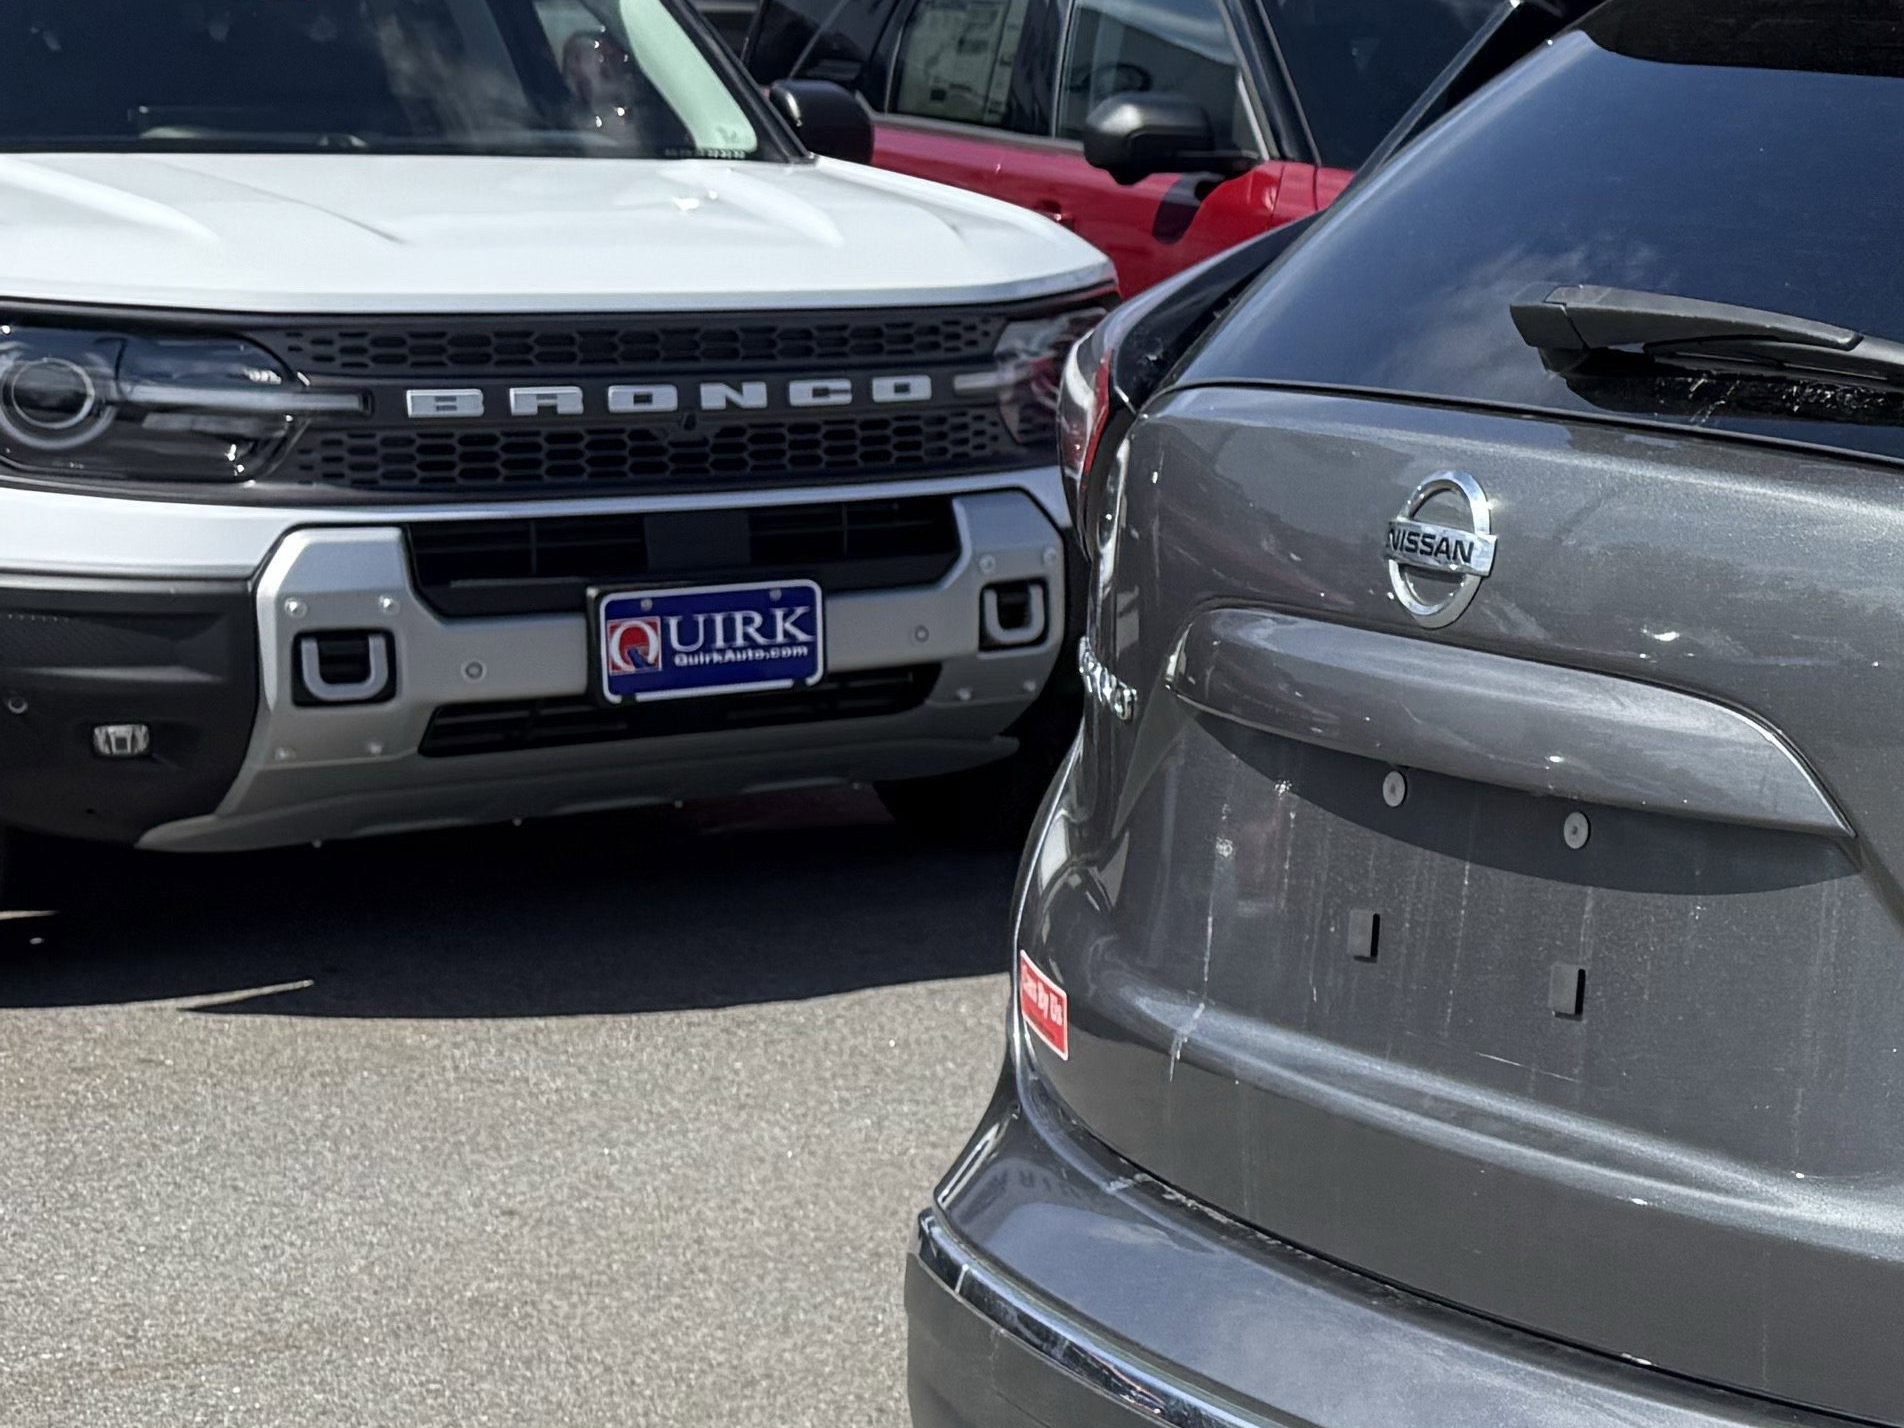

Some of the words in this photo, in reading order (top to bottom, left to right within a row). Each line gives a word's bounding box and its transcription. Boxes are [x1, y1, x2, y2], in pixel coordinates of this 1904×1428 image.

[406, 375, 932, 418] BRONCO
[1386, 528, 1474, 564] NISSAN
[609, 606, 815, 671] QUIRK
